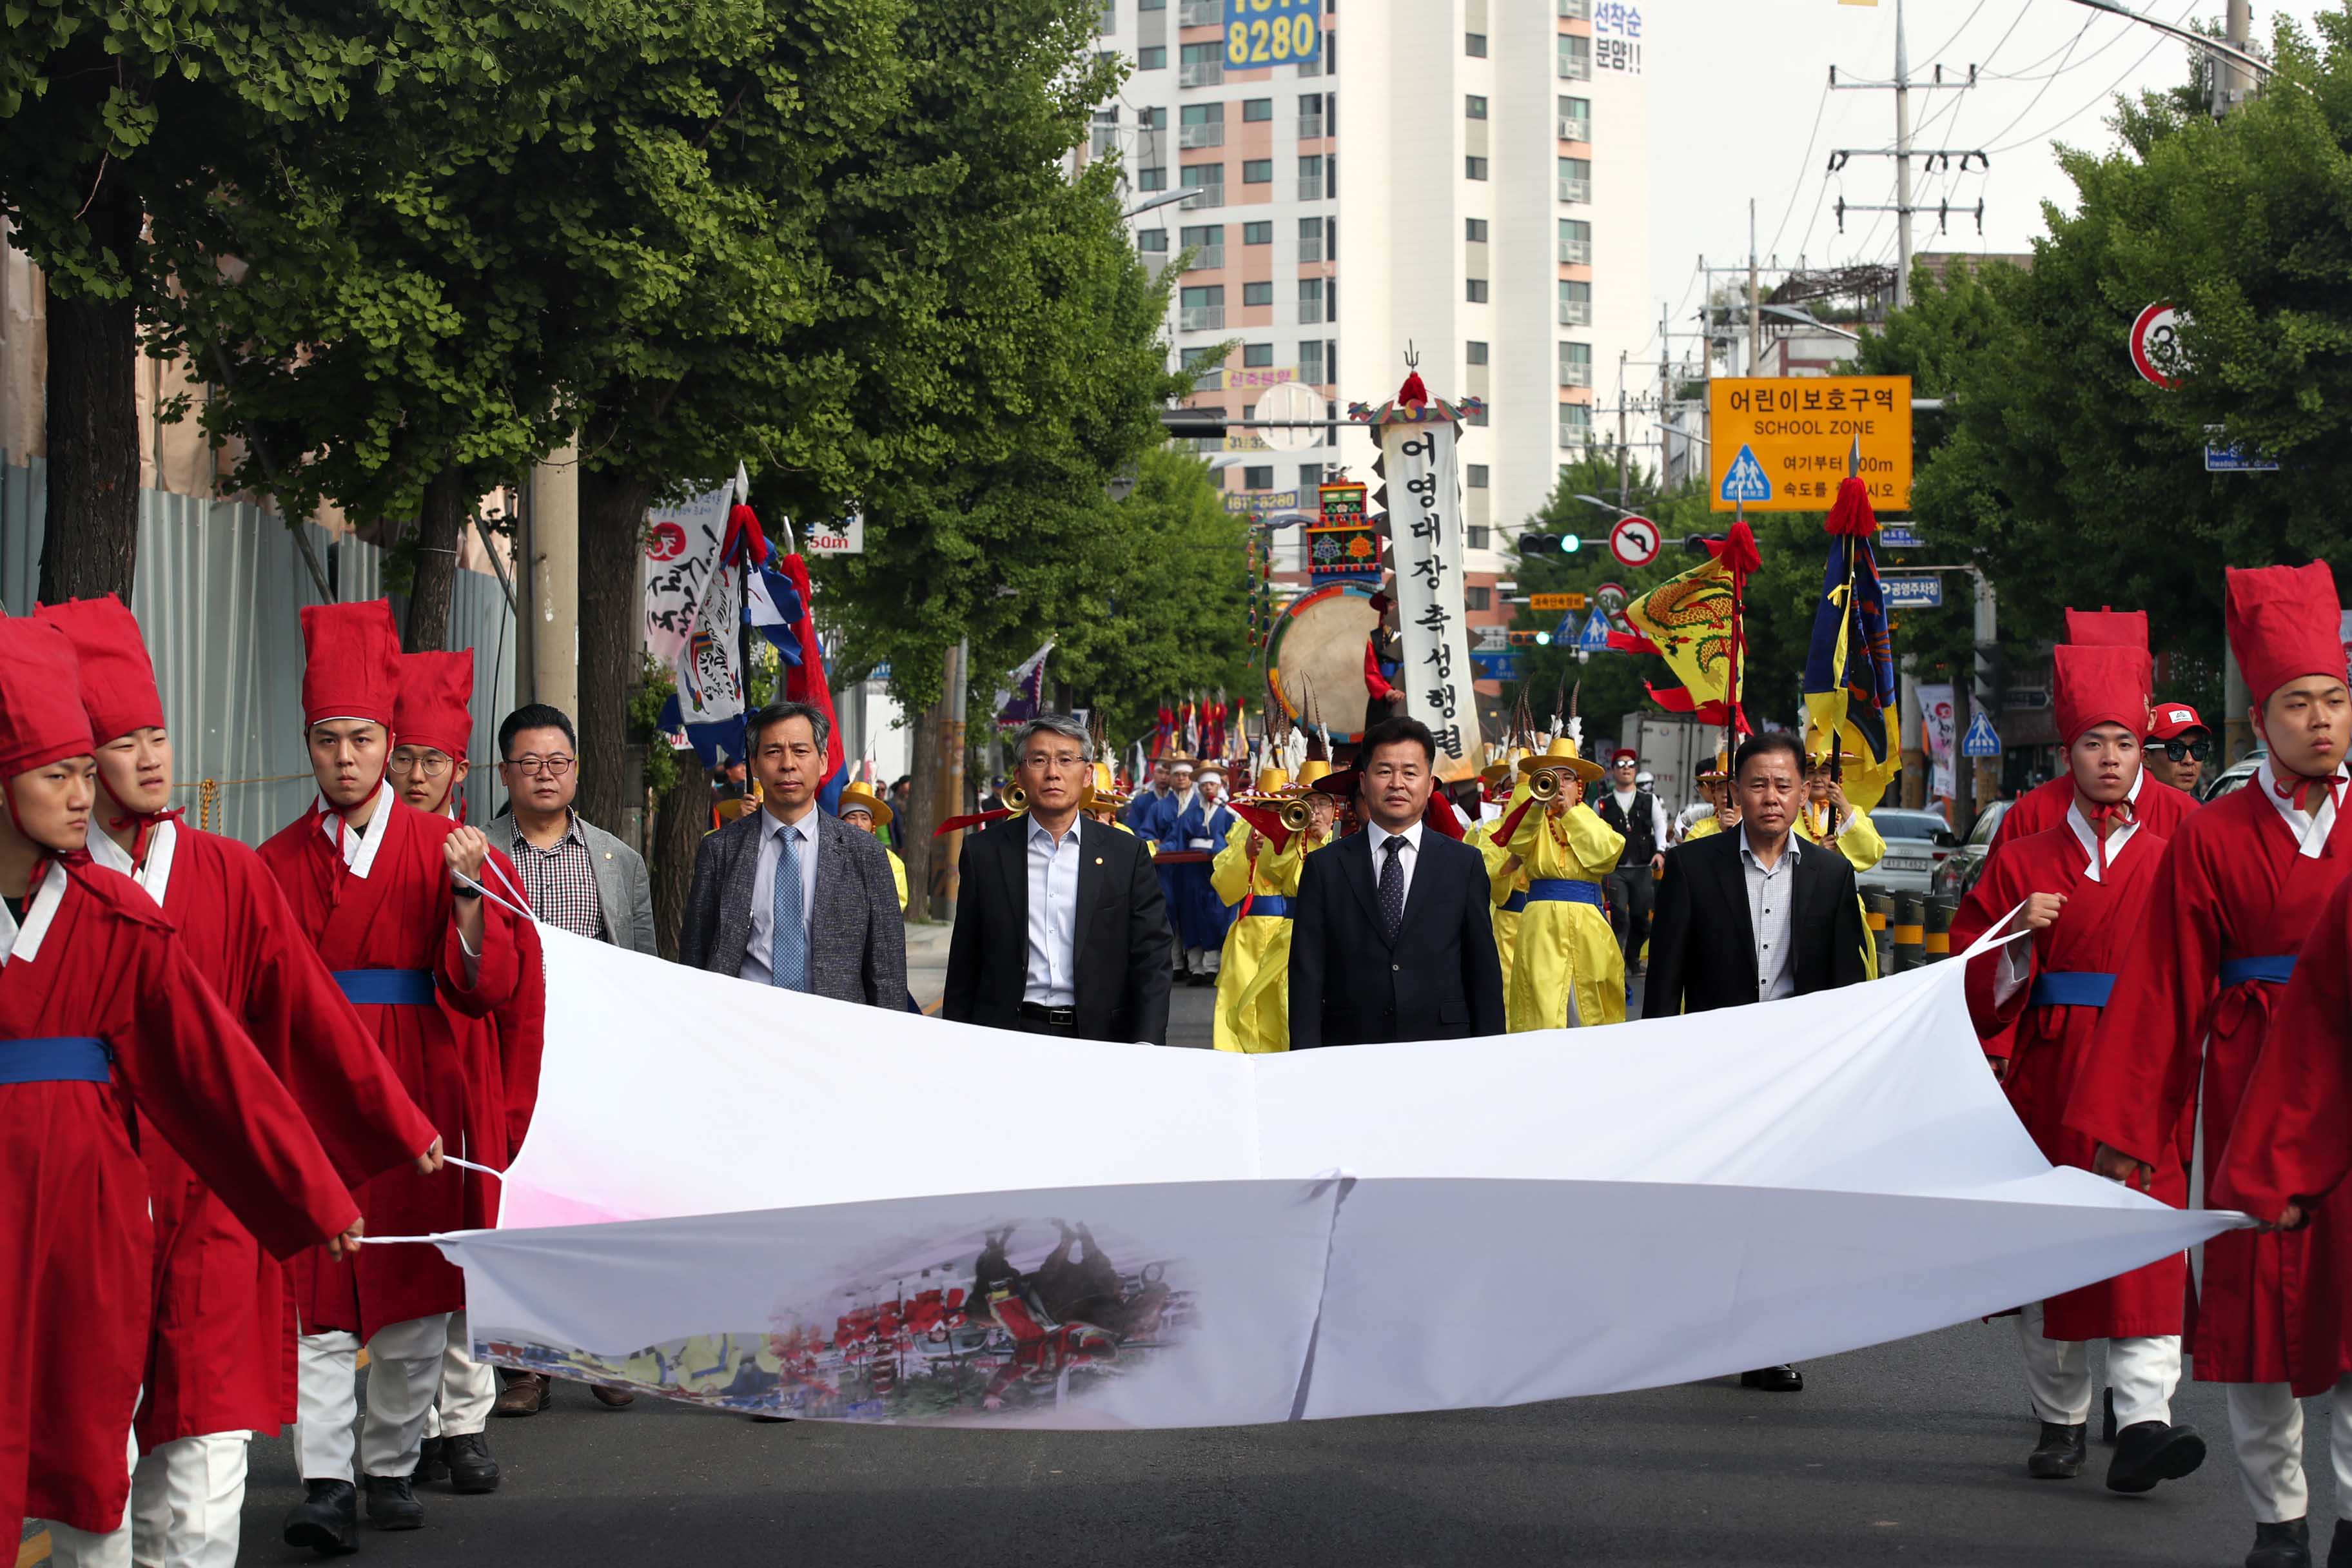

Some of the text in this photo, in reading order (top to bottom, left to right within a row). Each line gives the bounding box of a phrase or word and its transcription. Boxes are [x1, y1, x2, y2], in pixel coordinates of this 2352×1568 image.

[1595, 3, 1641, 37] 선착순
[1228, 13, 1314, 64] 8280
[1596, 37, 1640, 74] 분양!!
[1730, 388, 1893, 413] 어린이보호구역
[1754, 420, 1874, 435] SCHOOL ZONE
[1783, 456, 1893, 471] 여기부터 00m
[1784, 483, 1827, 497] 속도를
[1402, 431, 1463, 760] 어영대장 축성행렬
[1892, 582, 1938, 596] 공영주차장
